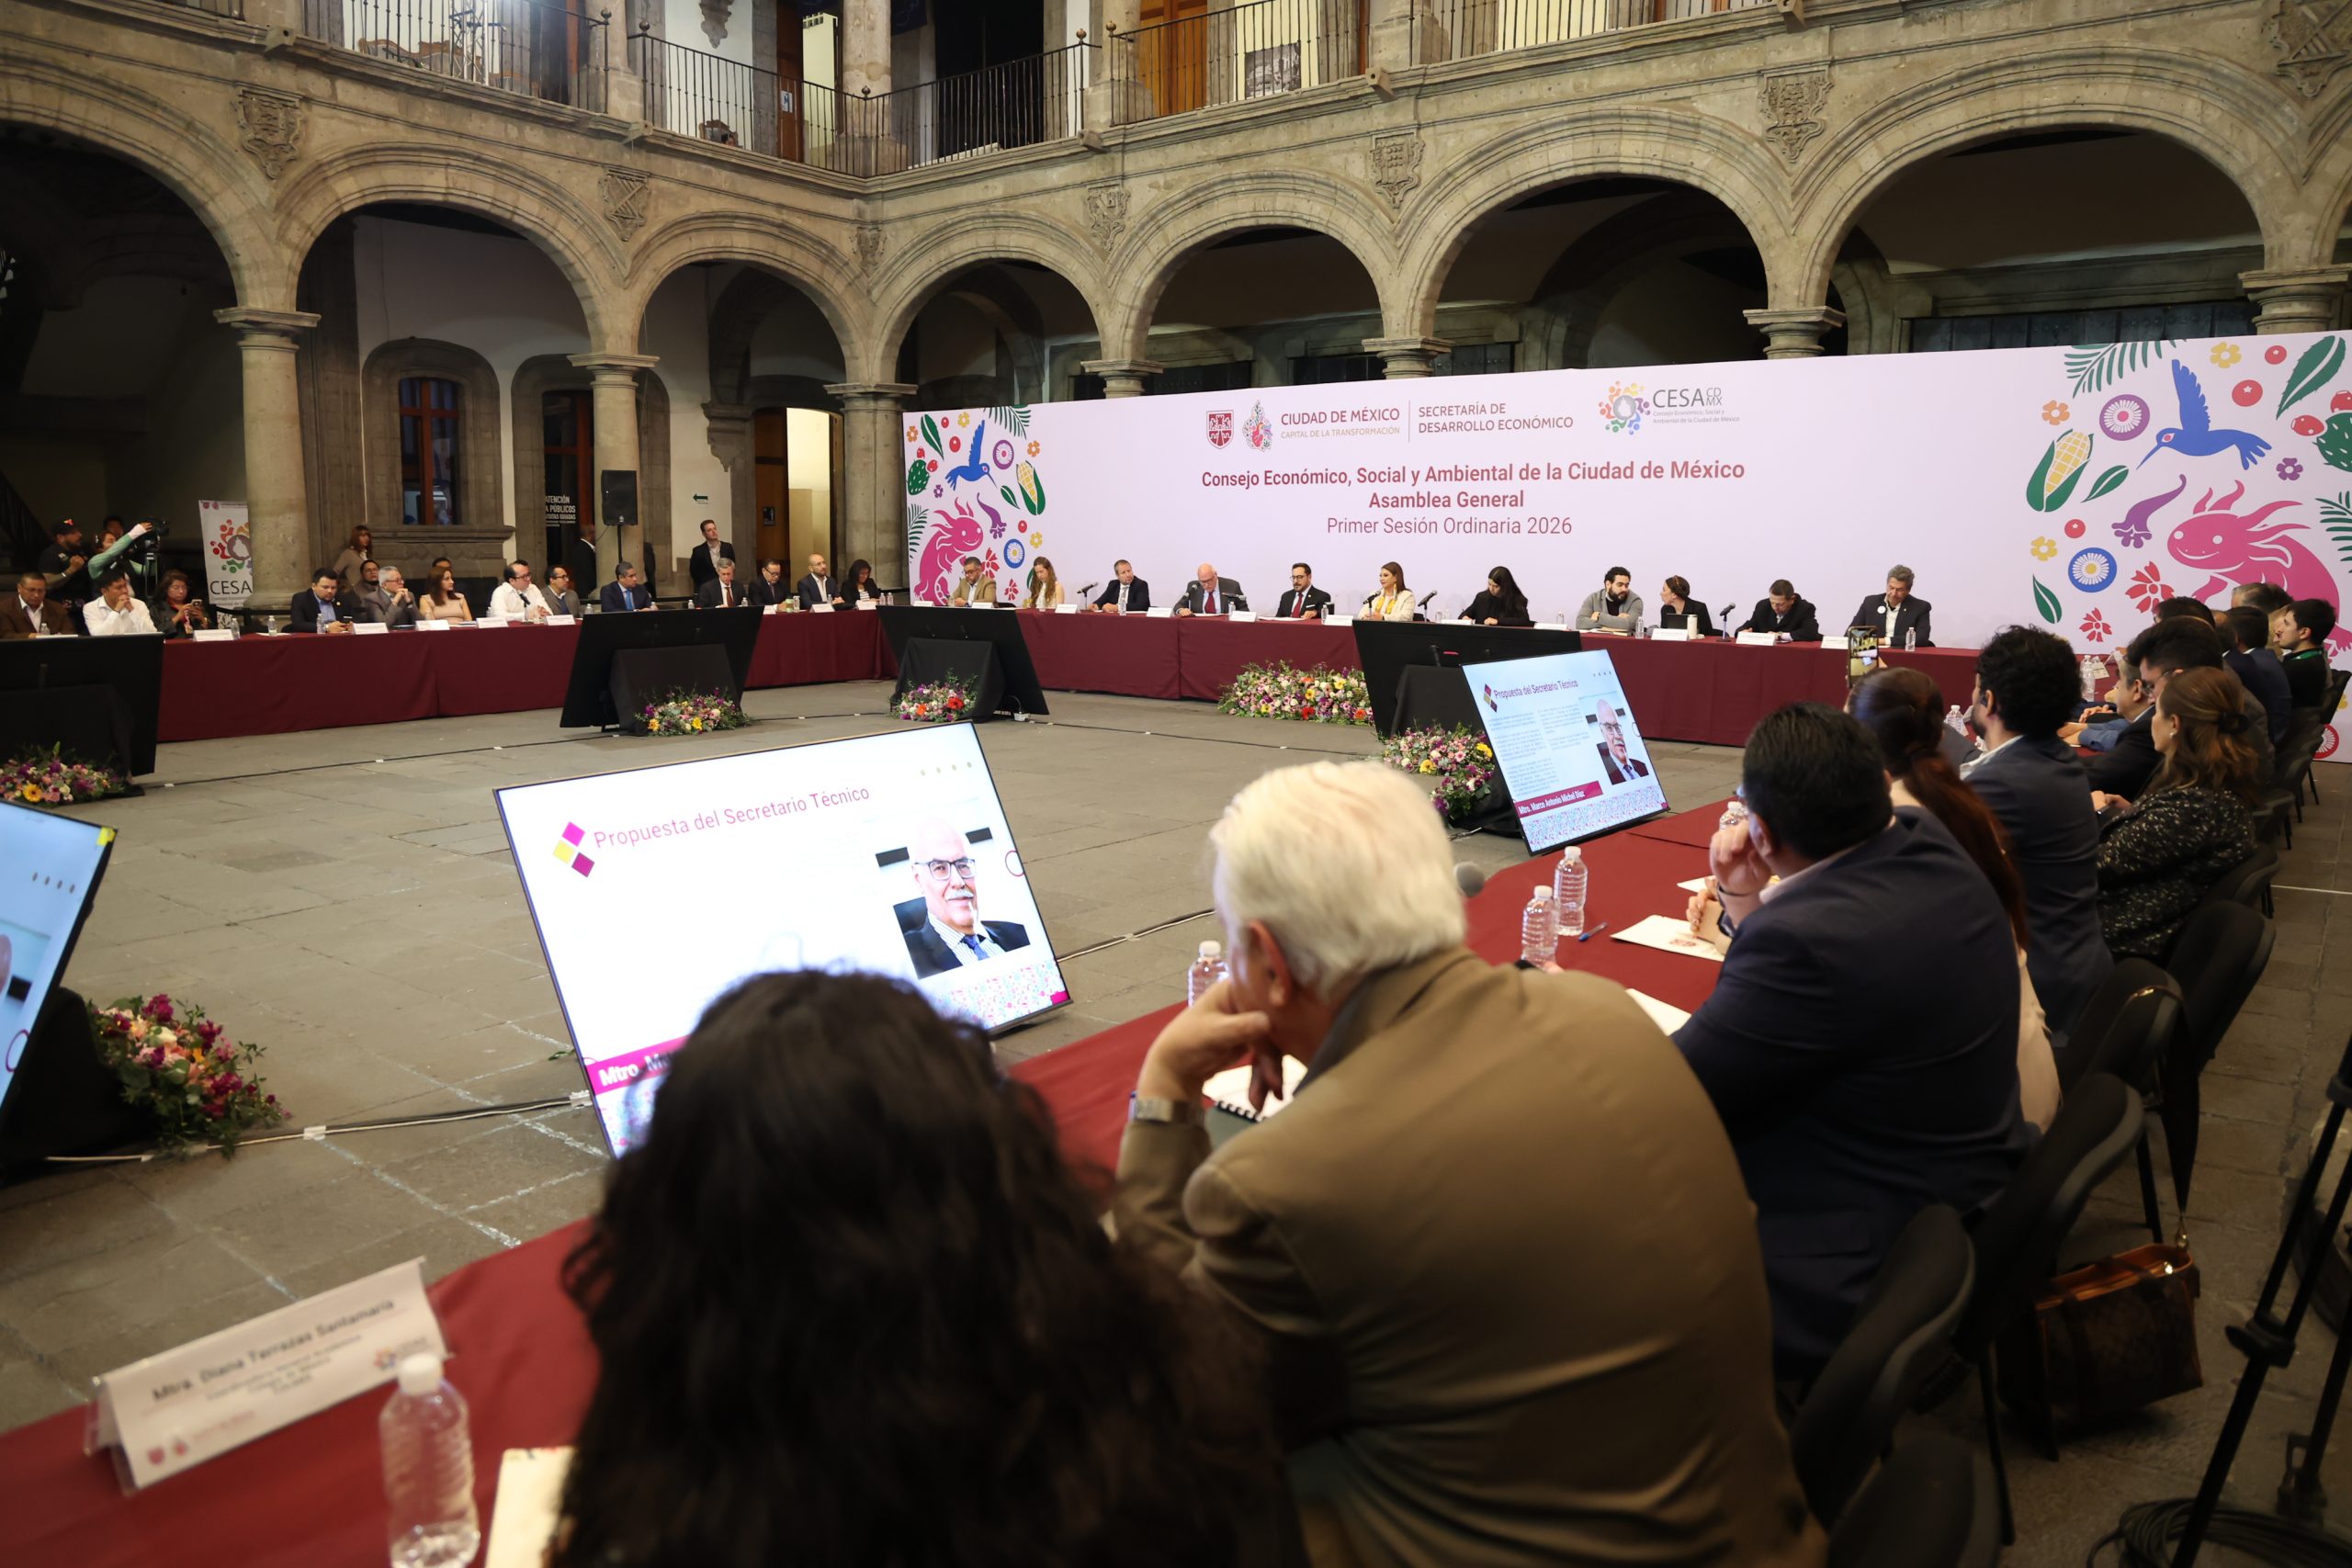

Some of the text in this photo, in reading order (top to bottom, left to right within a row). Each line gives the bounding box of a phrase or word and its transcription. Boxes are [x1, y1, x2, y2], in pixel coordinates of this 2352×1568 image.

[1653, 389, 1704, 408] CESA
[1706, 388, 1722, 397] CD
[1706, 397, 1723, 406] MX
[1281, 407, 1399, 425] CIUDAD DE MÉXICO
[1419, 401, 1506, 417] SECRETARÍA DE
[1281, 426, 1399, 439] CAPITAL DE LA TRANSFORMACIÓN
[1419, 415, 1573, 433] DESARROLLO ECONÓMICO
[1202, 460, 1745, 490] Consejo Económico, Social y Ambiental de la Ciudad de México
[1369, 490, 1524, 508] Asamblea General
[1328, 516, 1572, 535] Primer Sesión Ordinaria 2026
[210, 581, 253, 595] CESA
[1494, 687, 1522, 700] Propuesta
[1523, 685, 1532, 694] del
[1532, 682, 1558, 694] Secretario
[594, 787, 869, 848] Propuesta del Secretario Técnico
